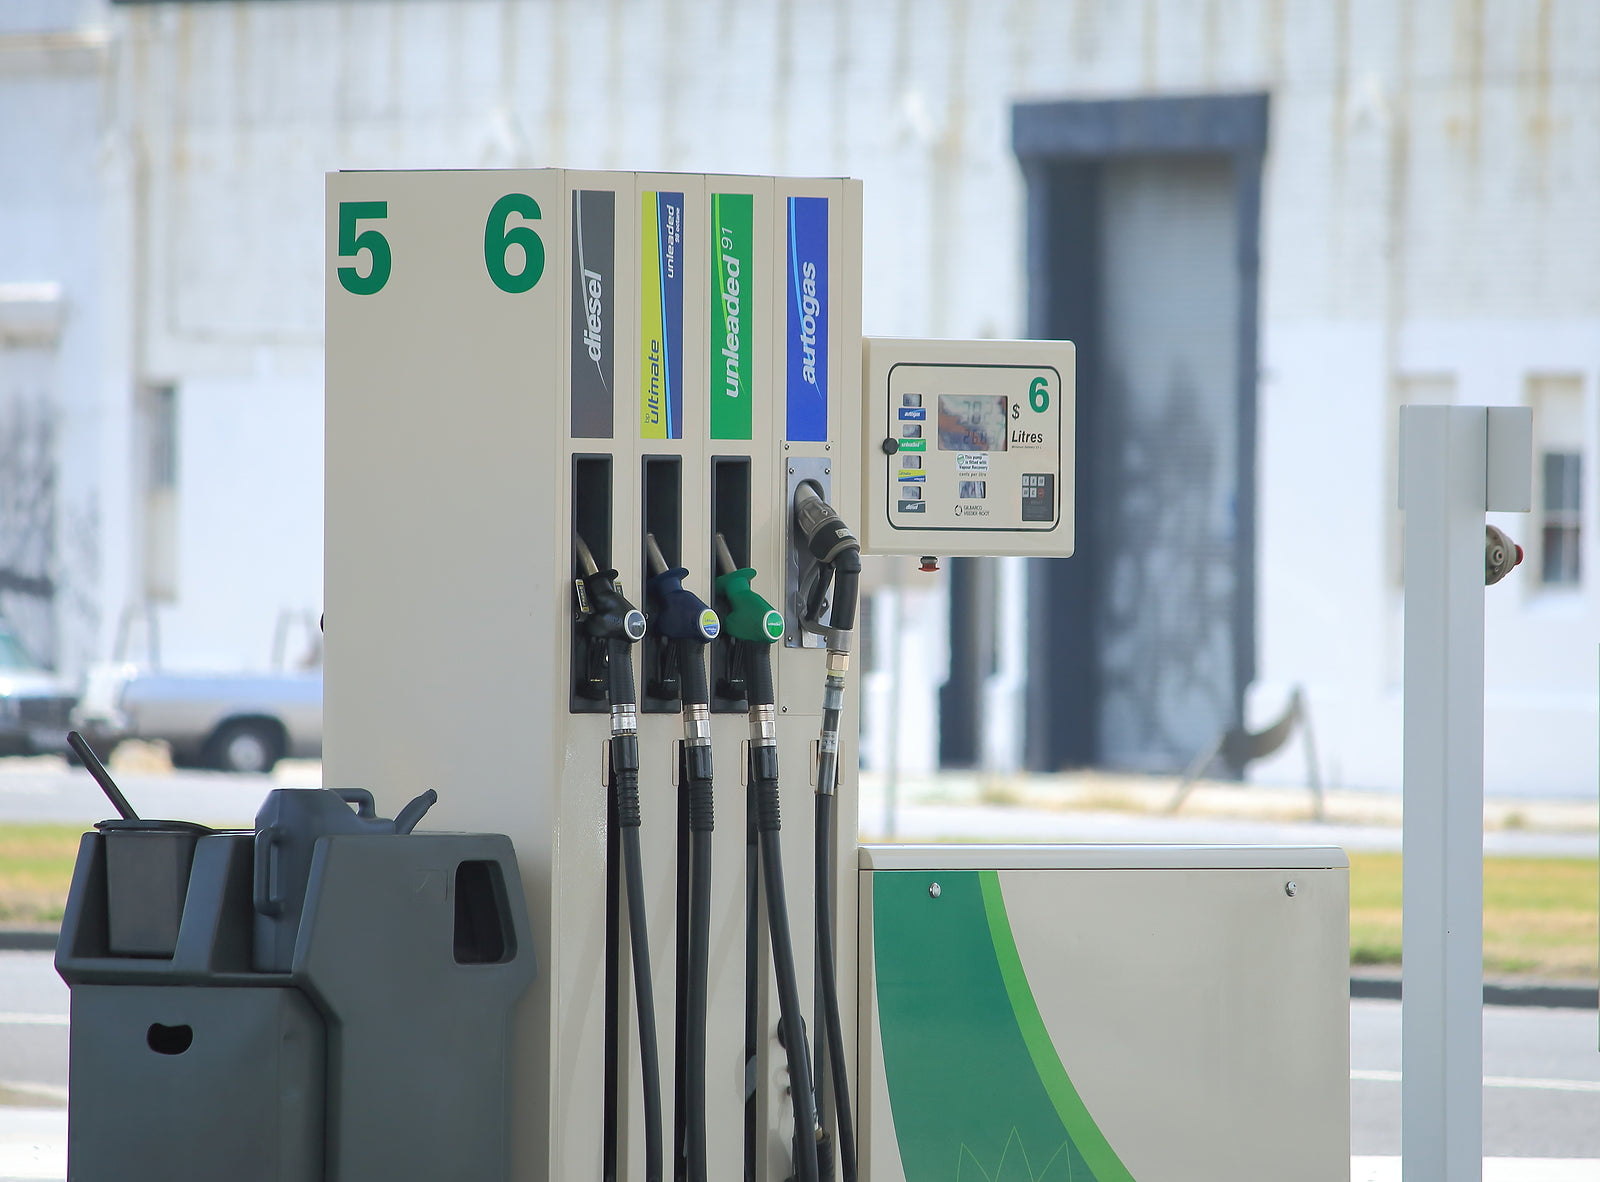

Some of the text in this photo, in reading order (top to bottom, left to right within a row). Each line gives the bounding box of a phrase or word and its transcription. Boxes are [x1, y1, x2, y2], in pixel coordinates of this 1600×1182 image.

[336, 200, 393, 296] 5
[484, 193, 546, 294] 6
[665, 204, 675, 279] unleaded
[583, 268, 603, 362] diesel
[720, 226, 741, 399] unleaded 91
[800, 261, 820, 385] autogas
[648, 339, 660, 425] ultimate
[1028, 376, 1050, 413] 6
[1011, 430, 1043, 443] Litres
